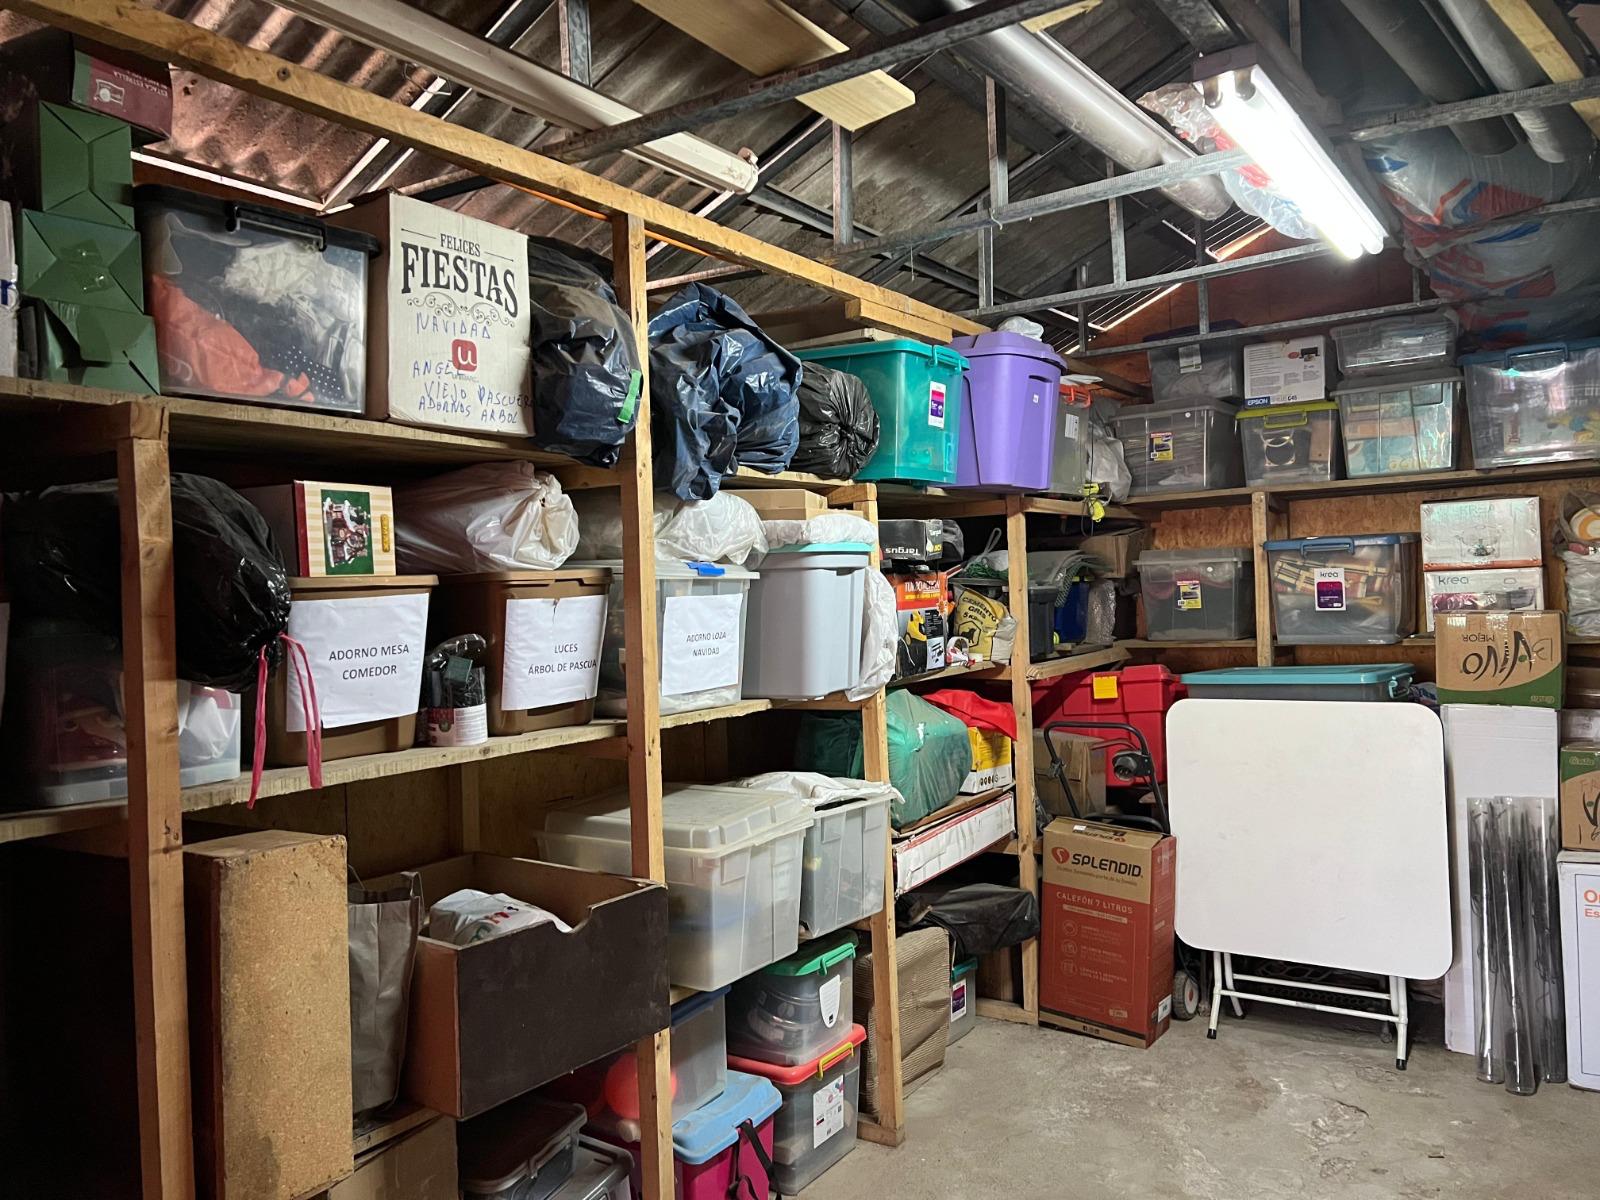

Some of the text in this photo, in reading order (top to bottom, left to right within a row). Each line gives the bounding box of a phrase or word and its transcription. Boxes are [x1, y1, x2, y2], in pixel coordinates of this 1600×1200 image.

[440, 233, 481, 257] FELICES
[401, 241, 518, 318] FIESTAS
[416, 313, 491, 339] NAVIDAD
[424, 381, 467, 402] VIEJO
[1247, 398, 1268, 406] EPSON
[481, 409, 518, 423] ARBOL
[885, 546, 920, 556] Targus
[1438, 575, 1469, 585] krea
[962, 597, 997, 622] CEMENTO
[968, 605, 986, 619] GRIS
[1462, 633, 1495, 642] MEJOR
[328, 644, 409, 661] ADORNO MESA
[554, 643, 578, 654] LUCES
[692, 647, 720, 656] NAVIDAD
[342, 664, 397, 680] COMEDOR
[528, 659, 597, 675] ÁRBOL DE PASCUA
[1071, 853, 1142, 878] SPLENDID
[1056, 891, 1094, 906] CALEFÓN
[1102, 902, 1133, 914] LITROS
